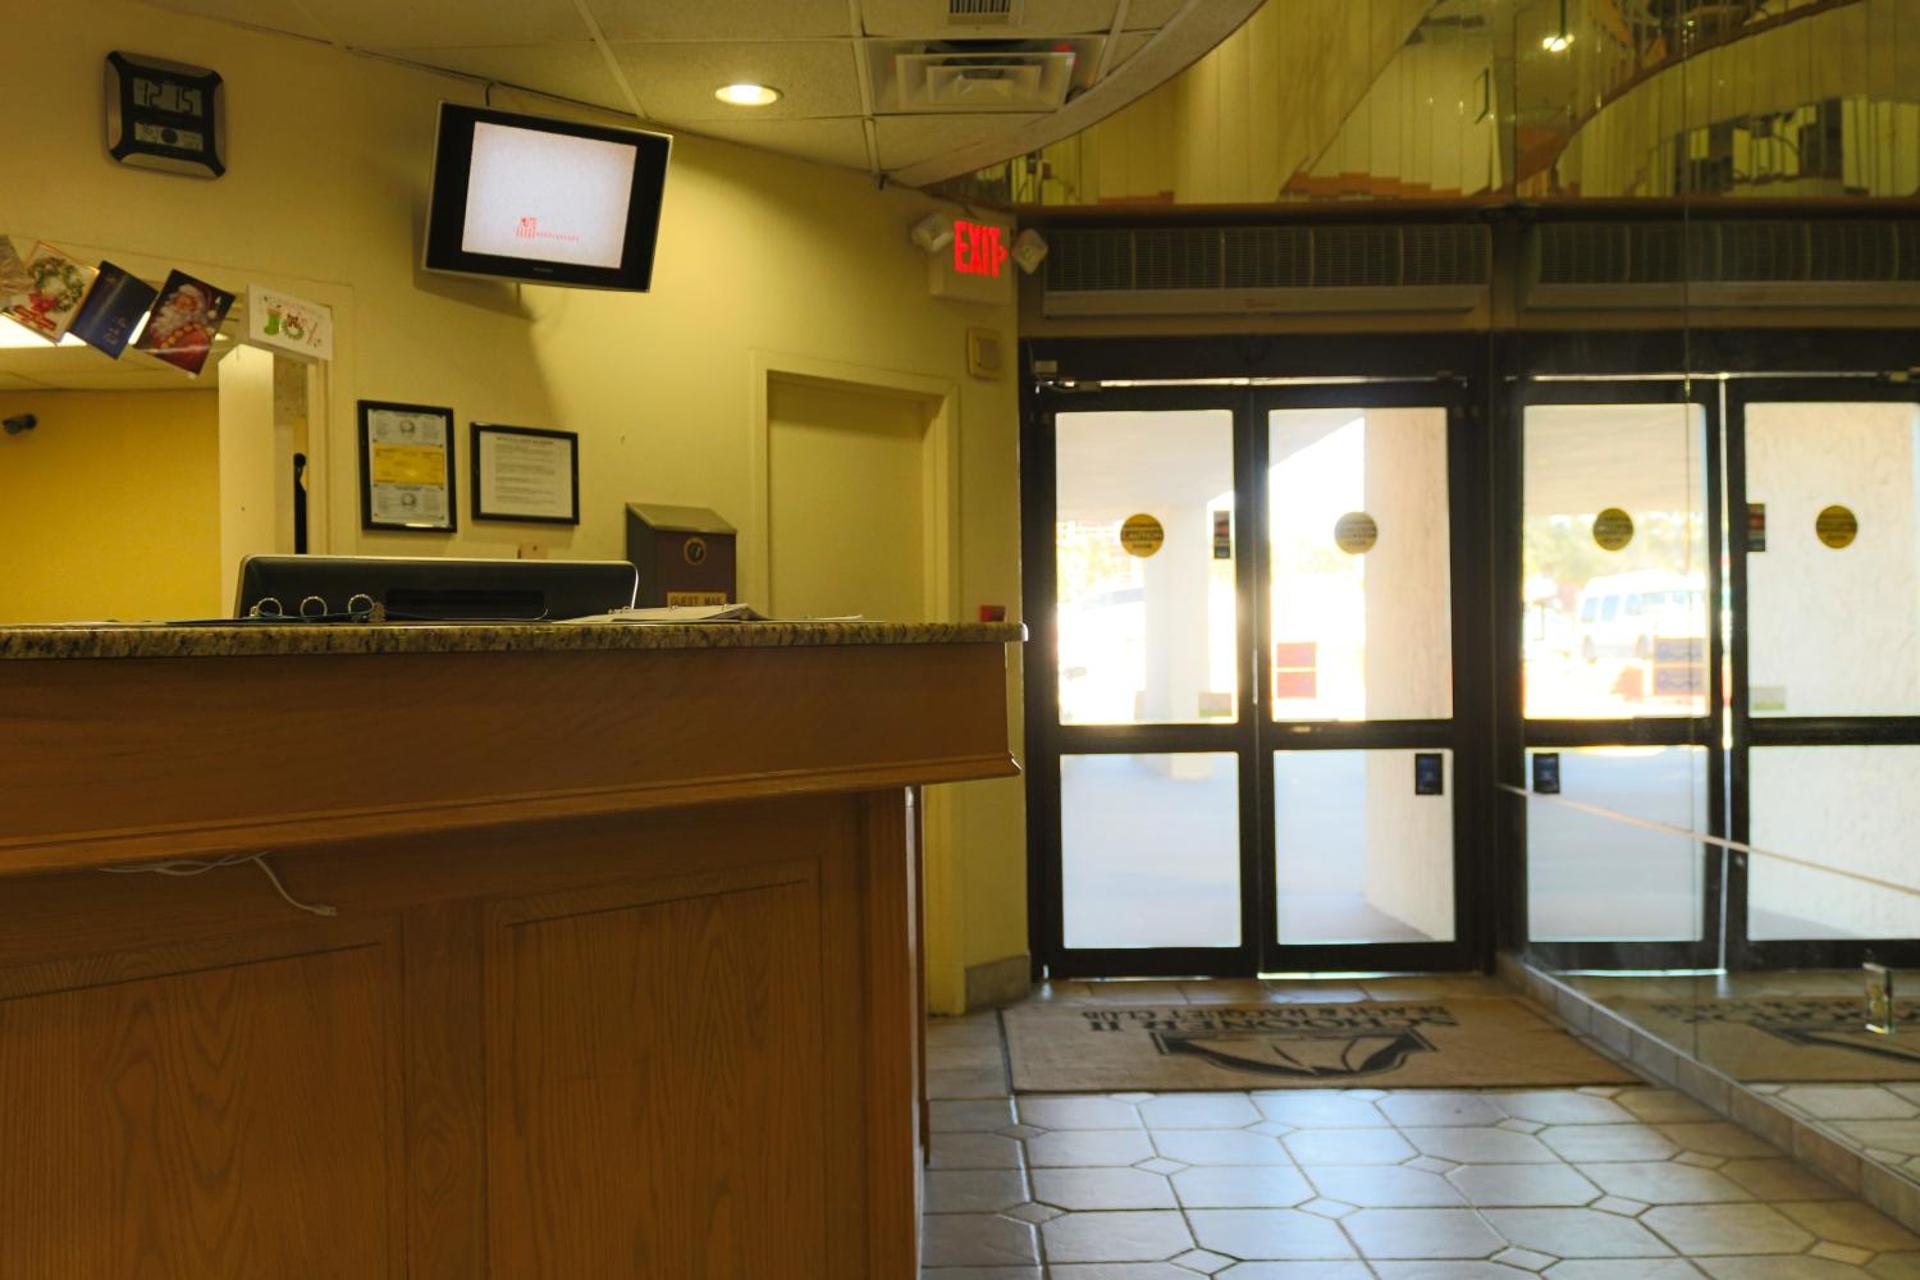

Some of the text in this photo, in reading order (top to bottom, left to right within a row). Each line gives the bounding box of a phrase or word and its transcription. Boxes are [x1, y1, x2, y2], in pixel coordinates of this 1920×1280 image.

[953, 219, 1001, 279] EXIT
[671, 595, 699, 606] GUEST
[1081, 1010, 1156, 1021] CLUB
[1171, 1008, 1308, 1020] RACQUET
[1090, 1016, 1458, 1032] SCHOONER II
